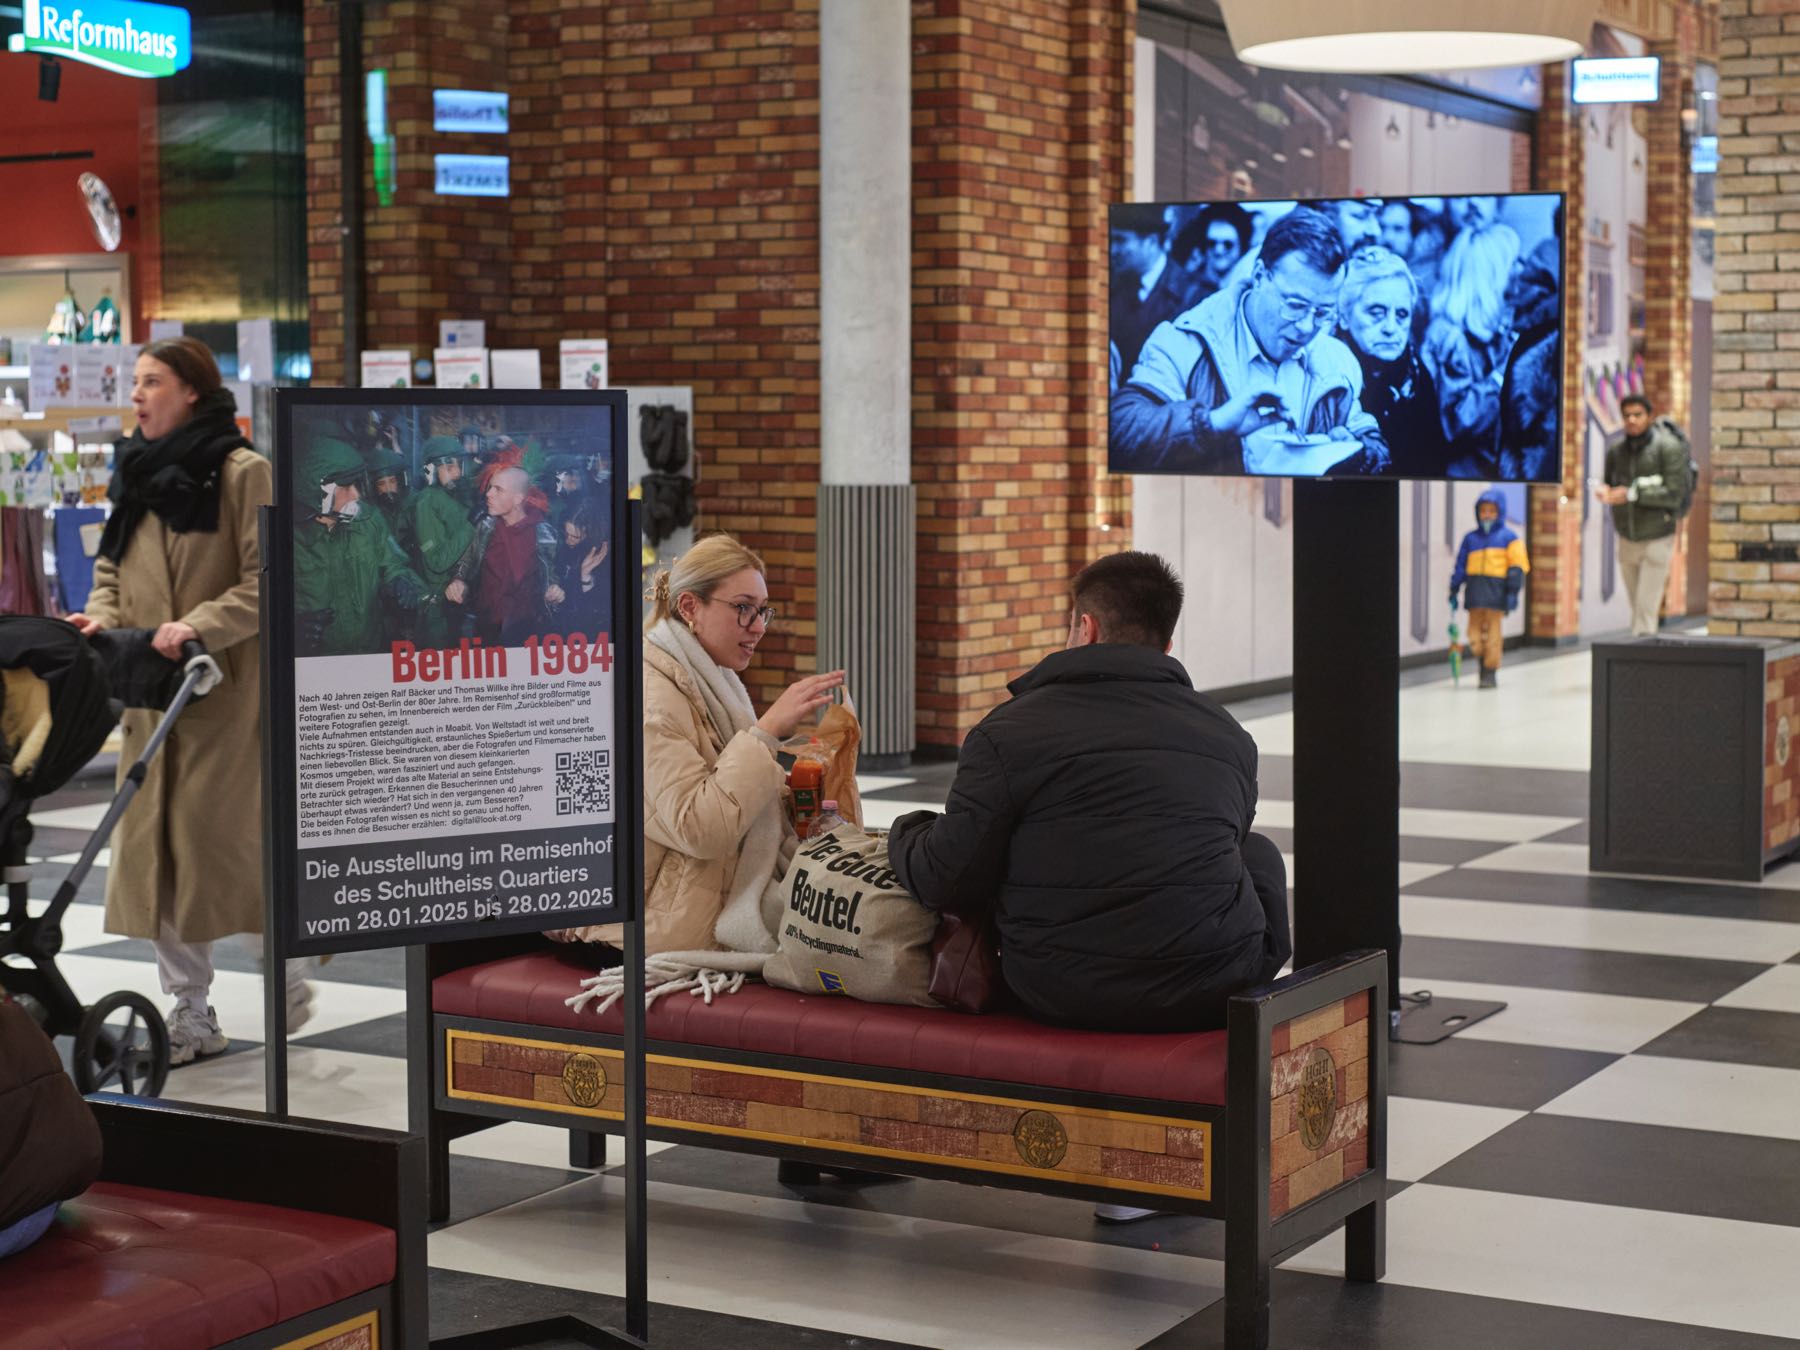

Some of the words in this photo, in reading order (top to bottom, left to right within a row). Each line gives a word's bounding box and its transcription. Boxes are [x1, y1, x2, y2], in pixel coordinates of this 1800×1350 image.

[42, 6, 177, 59] Reformhaus
[391, 637, 507, 683] Berlin
[524, 632, 613, 676] 1984
[299, 694, 320, 703] Nach
[322, 693, 333, 701] 40
[334, 693, 361, 701] Jahren
[363, 691, 389, 700] zeigen
[391, 689, 407, 698] Ralf
[408, 688, 436, 697] Bäcker
[437, 687, 452, 695] und
[454, 686, 485, 694] Thomas
[527, 682, 549, 691] Bilder
[550, 681, 565, 689] und
[566, 680, 587, 688] Filme
[299, 704, 318, 713] dem
[319, 703, 342, 711] West-
[344, 701, 360, 710] und
[361, 699, 401, 709] Ost-Berlin
[403, 699, 417, 707] der
[418, 698, 436, 706] 80er
[437, 697, 461, 705] Jahre.
[474, 693, 520, 702] Remisenhof
[521, 692, 537, 700] sind
[538, 689, 590, 700] großformatige
[299, 712, 346, 723] Fotografien
[359, 711, 386, 719] sehen,
[387, 709, 398, 717] im
[399, 706, 450, 716] Innenbereich
[451, 705, 480, 713] werden
[482, 704, 495, 712] der
[577, 698, 591, 706] und
[299, 723, 330, 732] weitere
[331, 720, 377, 730] Fotografien
[378, 718, 410, 728] gezeigt.
[299, 733, 320, 742] Viele
[321, 731, 368, 740] Aufnahmen
[369, 728, 413, 737] entstanden
[415, 726, 434, 735] auch
[436, 725, 444, 733] in
[445, 723, 473, 732] Moabit.
[475, 723, 490, 731] Von
[492, 720, 527, 729] Weltstadt
[539, 719, 555, 727] weit
[556, 717, 571, 726] und
[572, 716, 590, 725] breit
[299, 743, 325, 751] nichts
[338, 740, 368, 750] spüren.
[370, 736, 433, 747] Gleichgültigkeit,
[435, 733, 486, 743] erstaunliches
[488, 730, 531, 740] Spießertum
[533, 728, 547, 736] und
[549, 725, 594, 735] konservierte
[299, 749, 384, 761] Nachkriegs-Tristesse
[385, 745, 441, 755] beeindrucken,
[442, 744, 460, 752] aber
[462, 742, 474, 750] die
[475, 740, 517, 750] Fotografen
[518, 738, 533, 747] und
[534, 736, 582, 745] Filmemacher
[583, 734, 606, 742] haben
[299, 762, 323, 771] einen
[324, 759, 367, 769] liebevollen
[369, 757, 391, 766] Blick.
[393, 756, 406, 764] Sie
[433, 754, 447, 762] von
[449, 752, 477, 760] diesem
[479, 749, 530, 758] kleinkarierten
[300, 772, 334, 780] Kosmos
[335, 768, 375, 778] umgeben,
[377, 767, 401, 775] waren
[403, 764, 439, 773] fasziniert
[440, 762, 455, 770] und
[457, 761, 476, 769] auch
[477, 759, 515, 769] gefangen.
[300, 782, 313, 790] Mit
[314, 781, 345, 789] diesem
[346, 777, 375, 787] Projekt
[376, 776, 394, 784] wird
[395, 775, 410, 783] das
[411, 774, 426, 782] alte
[428, 771, 459, 781] Material
[472, 769, 493, 778] seine
[494, 767, 543, 776] Entstehungs-
[300, 791, 317, 800] orte
[319, 789, 346, 798] zurück
[348, 787, 386, 797] getragen.
[388, 784, 425, 793] Erkennen
[427, 782, 439, 790] die
[441, 779, 498, 789] Besucherinnen
[499, 776, 514, 785] und
[300, 799, 343, 810] Betrachter
[345, 797, 362, 806] sich
[363, 795, 395, 805] wieder?
[397, 794, 411, 802] Hat
[412, 792, 429, 801] sich
[439, 791, 455, 799] den
[456, 788, 505, 798] vergangenen
[518, 785, 543, 793] Jahren
[300, 808, 343, 819] überhaupt
[344, 808, 368, 816] etwas
[369, 803, 412, 813] verändert?
[413, 802, 430, 810] Und
[431, 801, 453, 809] wenn
[454, 799, 464, 808] ja,
[483, 794, 524, 805] Besseren?
[300, 820, 315, 829] Die
[316, 818, 344, 828] beiden
[346, 815, 389, 825] Fotografen
[391, 813, 418, 821] wissen
[431, 809, 450, 818] nicht
[463, 808, 487, 817] genau
[489, 805, 504, 814] und
[505, 804, 532, 812] hoffen,
[300, 830, 321, 838] dass
[334, 828, 356, 836] ihnen
[358, 825, 371, 834] die
[372, 823, 410, 832] Besucher
[305, 859, 339, 880] Die
[346, 848, 463, 876] Ausstellung
[470, 847, 493, 865] im
[500, 835, 613, 862] Remisenhof
[826, 851, 899, 889] Gute
[334, 884, 371, 905] des
[378, 873, 493, 901] Schultheiss
[499, 866, 588, 888] Quartiers
[306, 916, 350, 935] vom
[357, 902, 468, 930] 28.01.2025
[474, 898, 502, 917] bis
[508, 887, 613, 914] 28.02.2025
[790, 868, 863, 935] Beutel.
